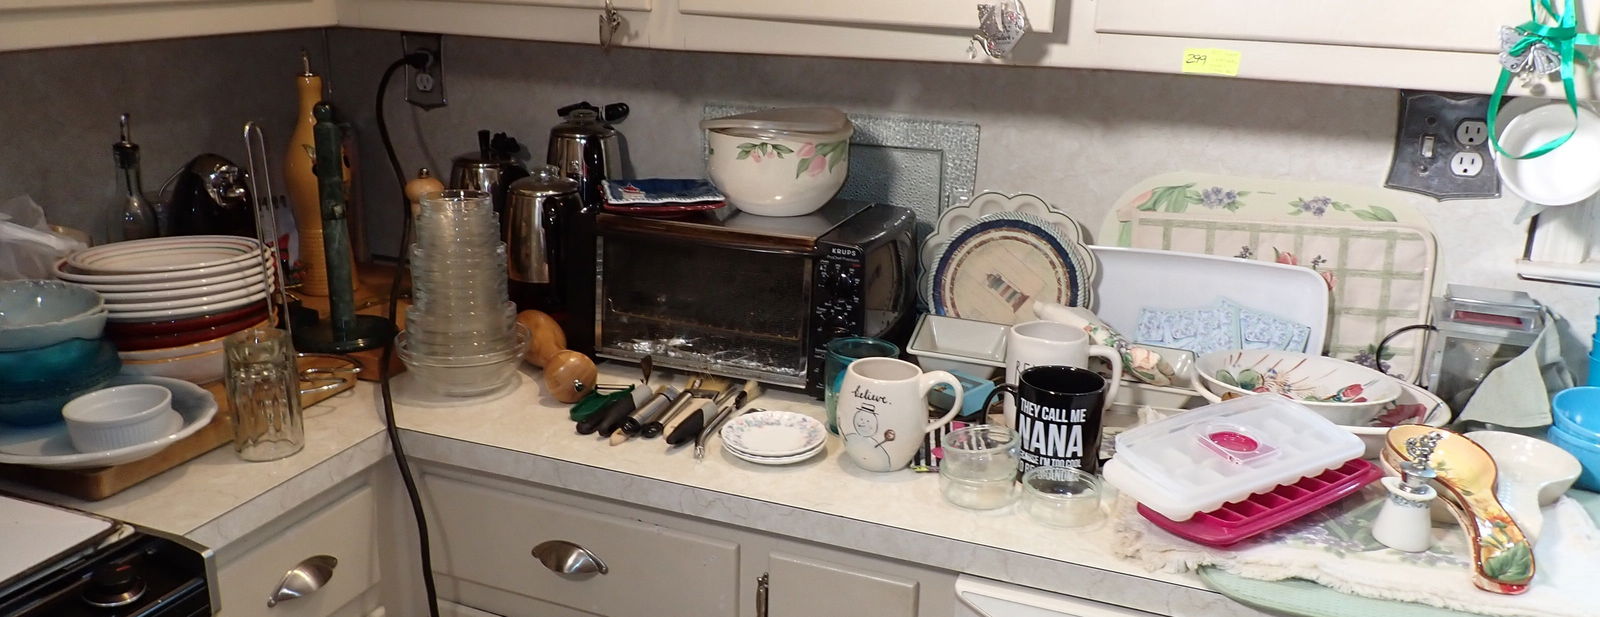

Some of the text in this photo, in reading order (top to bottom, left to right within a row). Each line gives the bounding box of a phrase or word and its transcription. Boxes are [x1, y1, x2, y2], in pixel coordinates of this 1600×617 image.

[831, 247, 857, 257] KRUPS
[1020, 397, 1087, 423] THEY CALL ME
[1019, 413, 1084, 458] NANA
[1051, 458, 1065, 468] TOO
[1065, 458, 1082, 469] COOL
